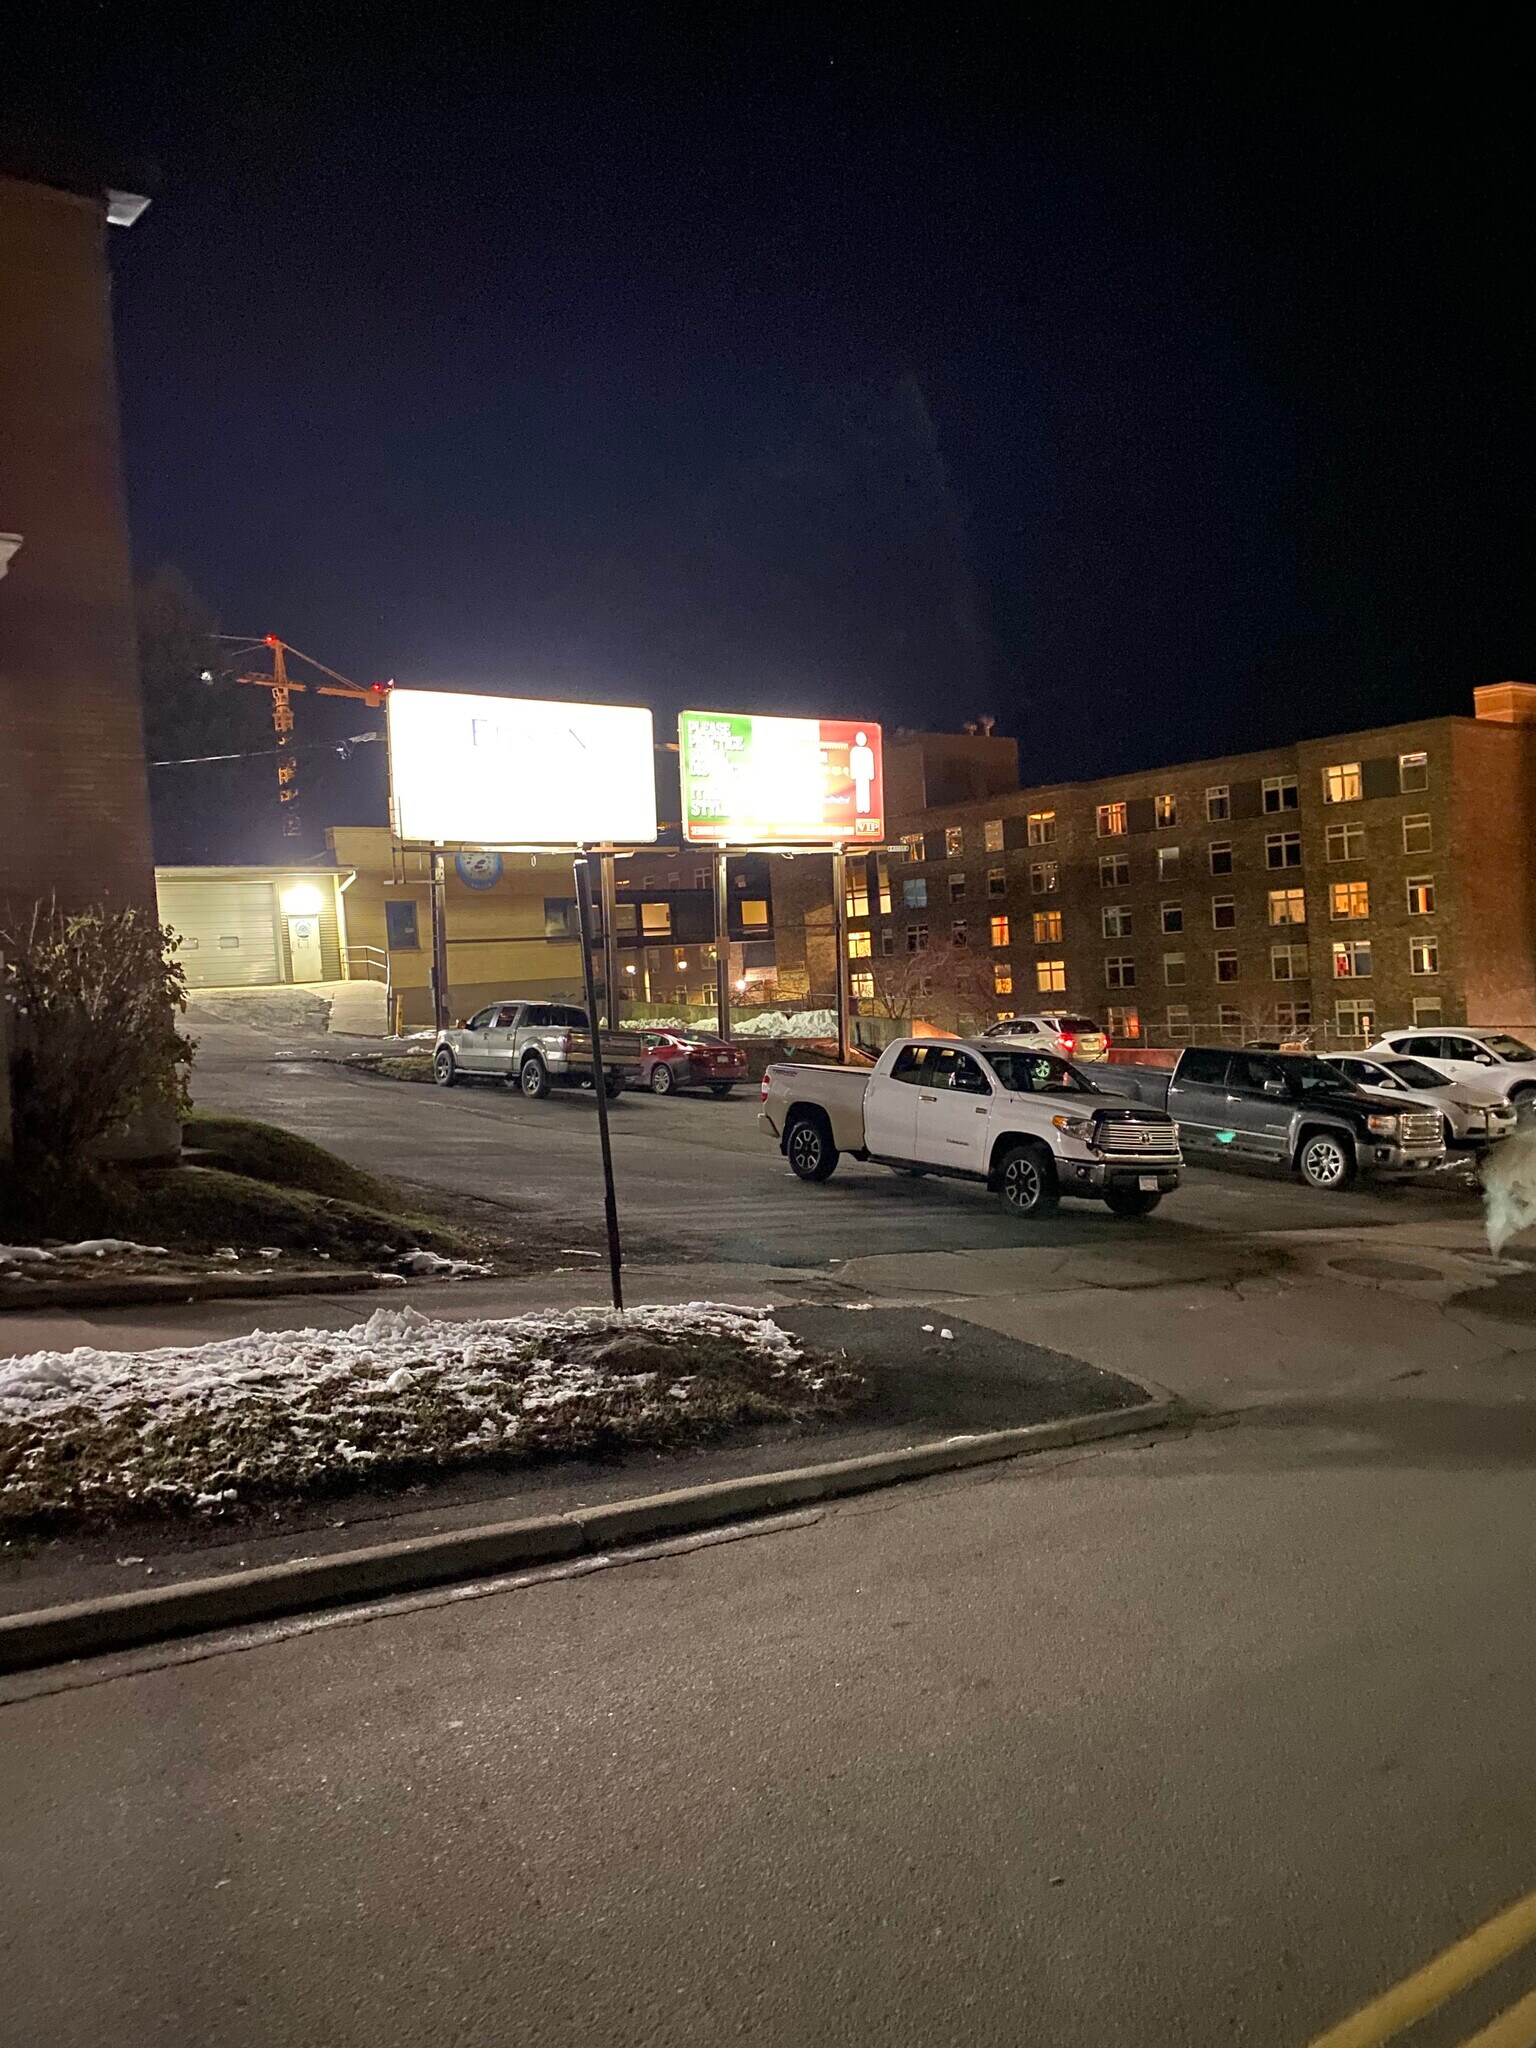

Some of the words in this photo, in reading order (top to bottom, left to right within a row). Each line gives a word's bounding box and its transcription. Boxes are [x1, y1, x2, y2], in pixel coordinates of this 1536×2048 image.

[688, 720, 731, 736] PLEASE
[688, 735, 744, 751] PTICE
[690, 800, 730, 817] STYL
[857, 822, 880, 832] VIP
